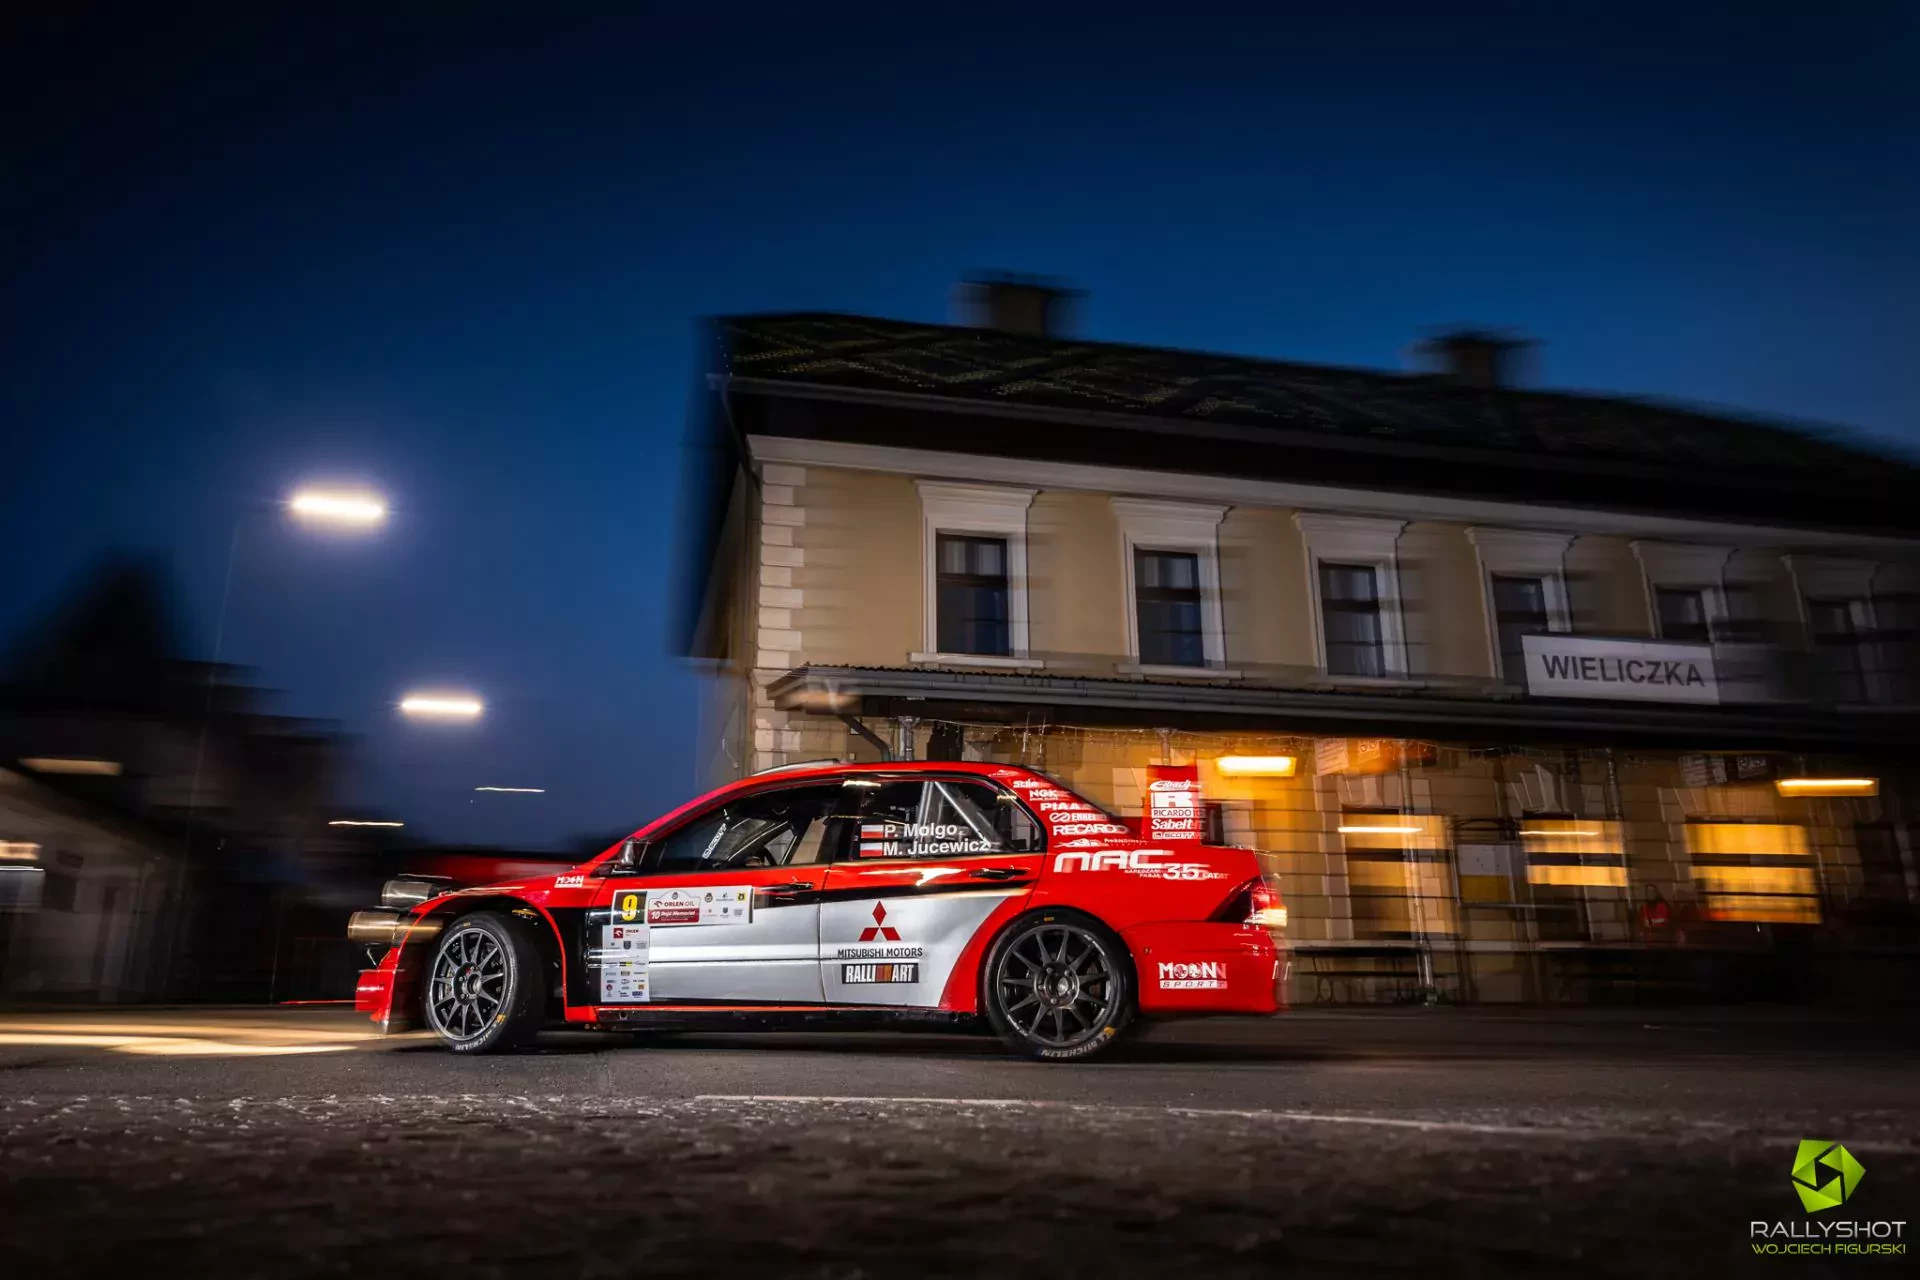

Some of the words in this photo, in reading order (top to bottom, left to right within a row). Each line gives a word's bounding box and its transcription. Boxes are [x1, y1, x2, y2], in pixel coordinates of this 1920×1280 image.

[1542, 654, 1705, 687] WIELICZKA
[1030, 789, 1058, 798] NGK
[1040, 802, 1081, 811] PIAA
[1153, 809, 1192, 817] RICARDO
[1053, 824, 1117, 836] RECARO
[1151, 818, 1193, 830] Sabelt
[884, 824, 898, 838] P.
[903, 822, 958, 839] Molgo
[883, 842, 902, 856] M.
[907, 838, 990, 855] Jucewicz
[1163, 863, 1199, 880] 35
[621, 894, 638, 922] 9
[651, 911, 660, 920] 10
[838, 948, 884, 958] MITSUBISHI
[886, 947, 923, 957] MOTORS
[1162, 980, 1215, 988] SPORT
